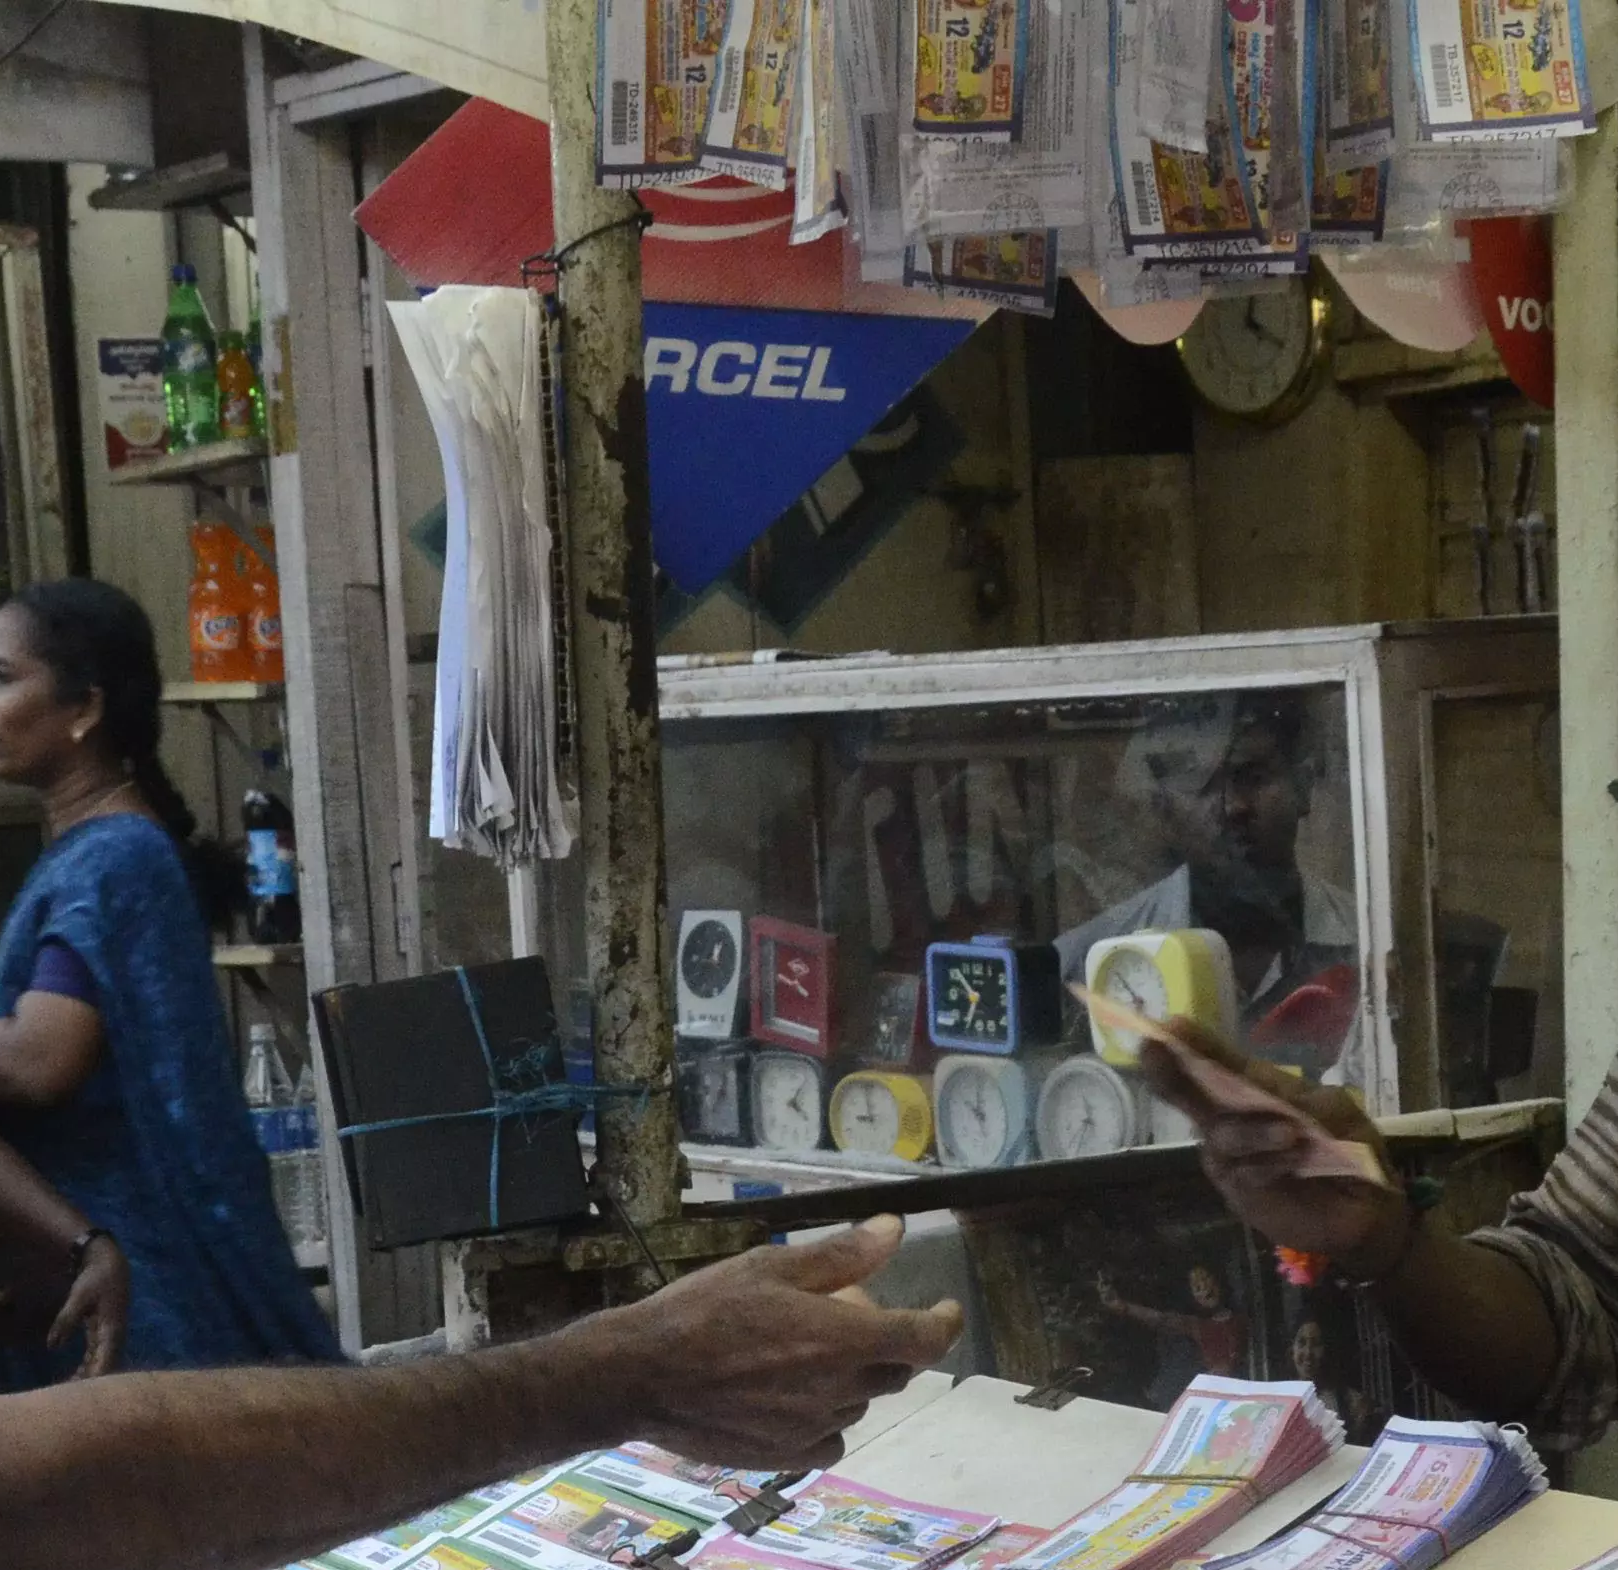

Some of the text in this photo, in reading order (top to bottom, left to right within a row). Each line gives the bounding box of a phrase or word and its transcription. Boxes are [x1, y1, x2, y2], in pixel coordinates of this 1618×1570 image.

[946, 17, 969, 37] 12
[1502, 20, 1524, 39] 12
[685, 64, 706, 83] 12
[644, 337, 846, 401] RCEL
